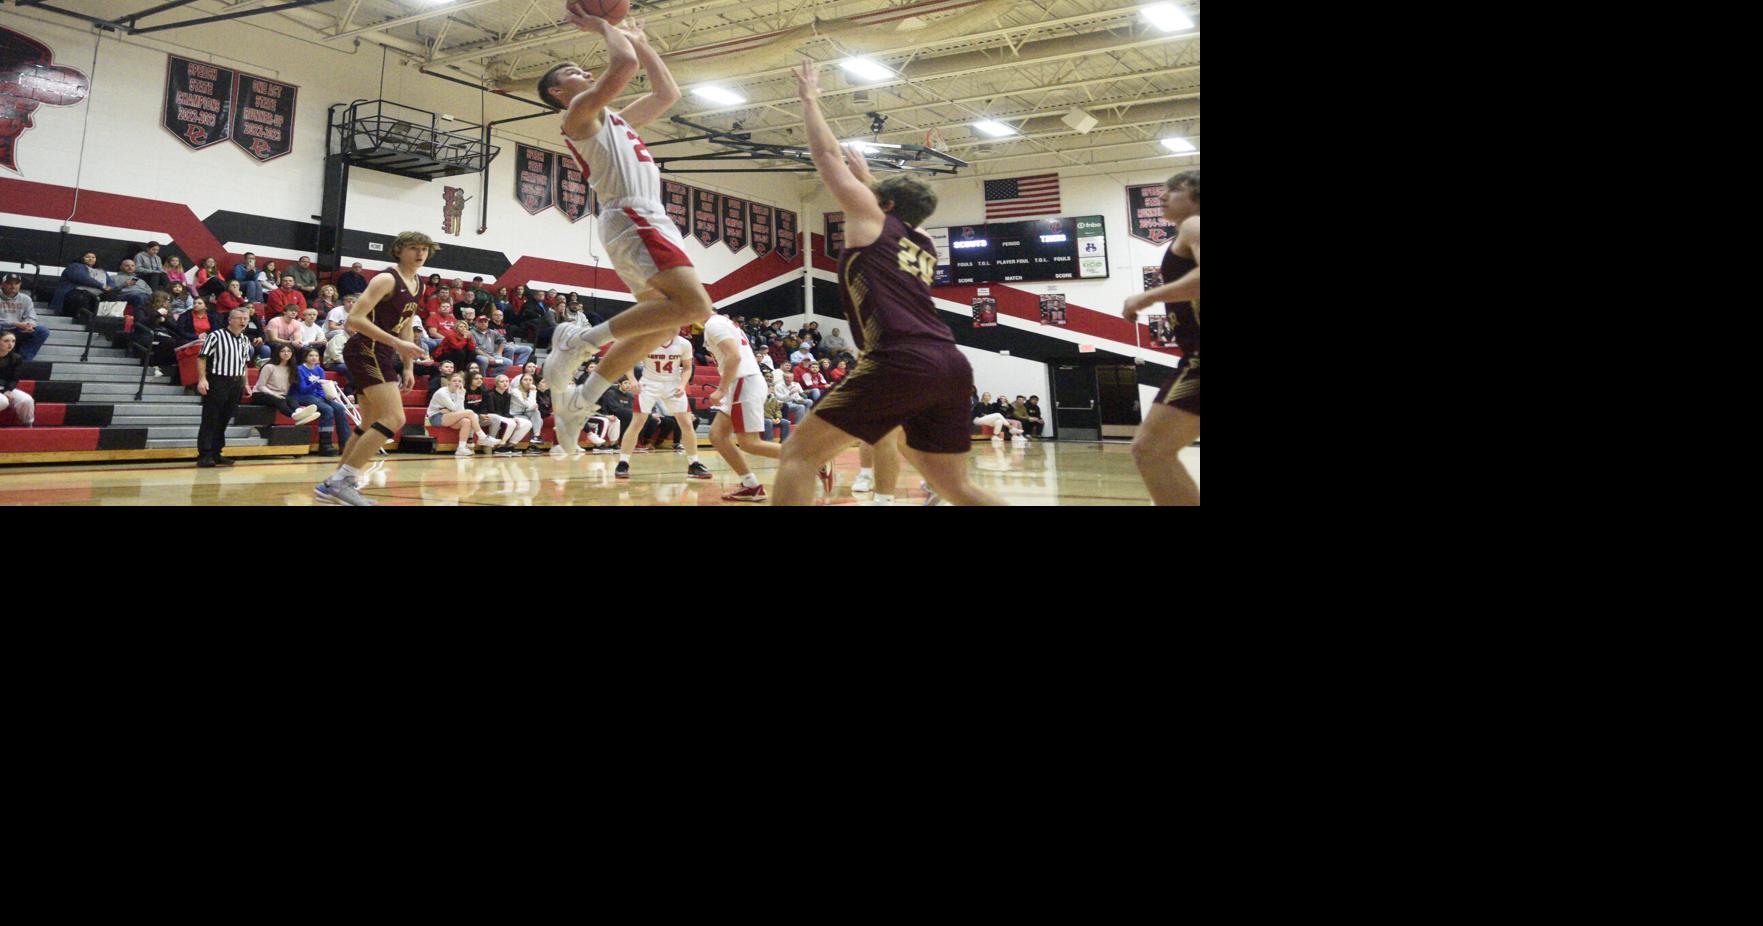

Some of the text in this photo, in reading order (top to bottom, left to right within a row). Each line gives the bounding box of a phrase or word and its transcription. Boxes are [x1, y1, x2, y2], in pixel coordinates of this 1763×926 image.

[188, 79, 214, 96] STATE
[176, 90, 220, 113] CHAMPIONS
[255, 95, 277, 112] STATE
[242, 107, 284, 128] RUNNER-UP
[897, 237, 937, 286] 20
[654, 360, 673, 374] 14
